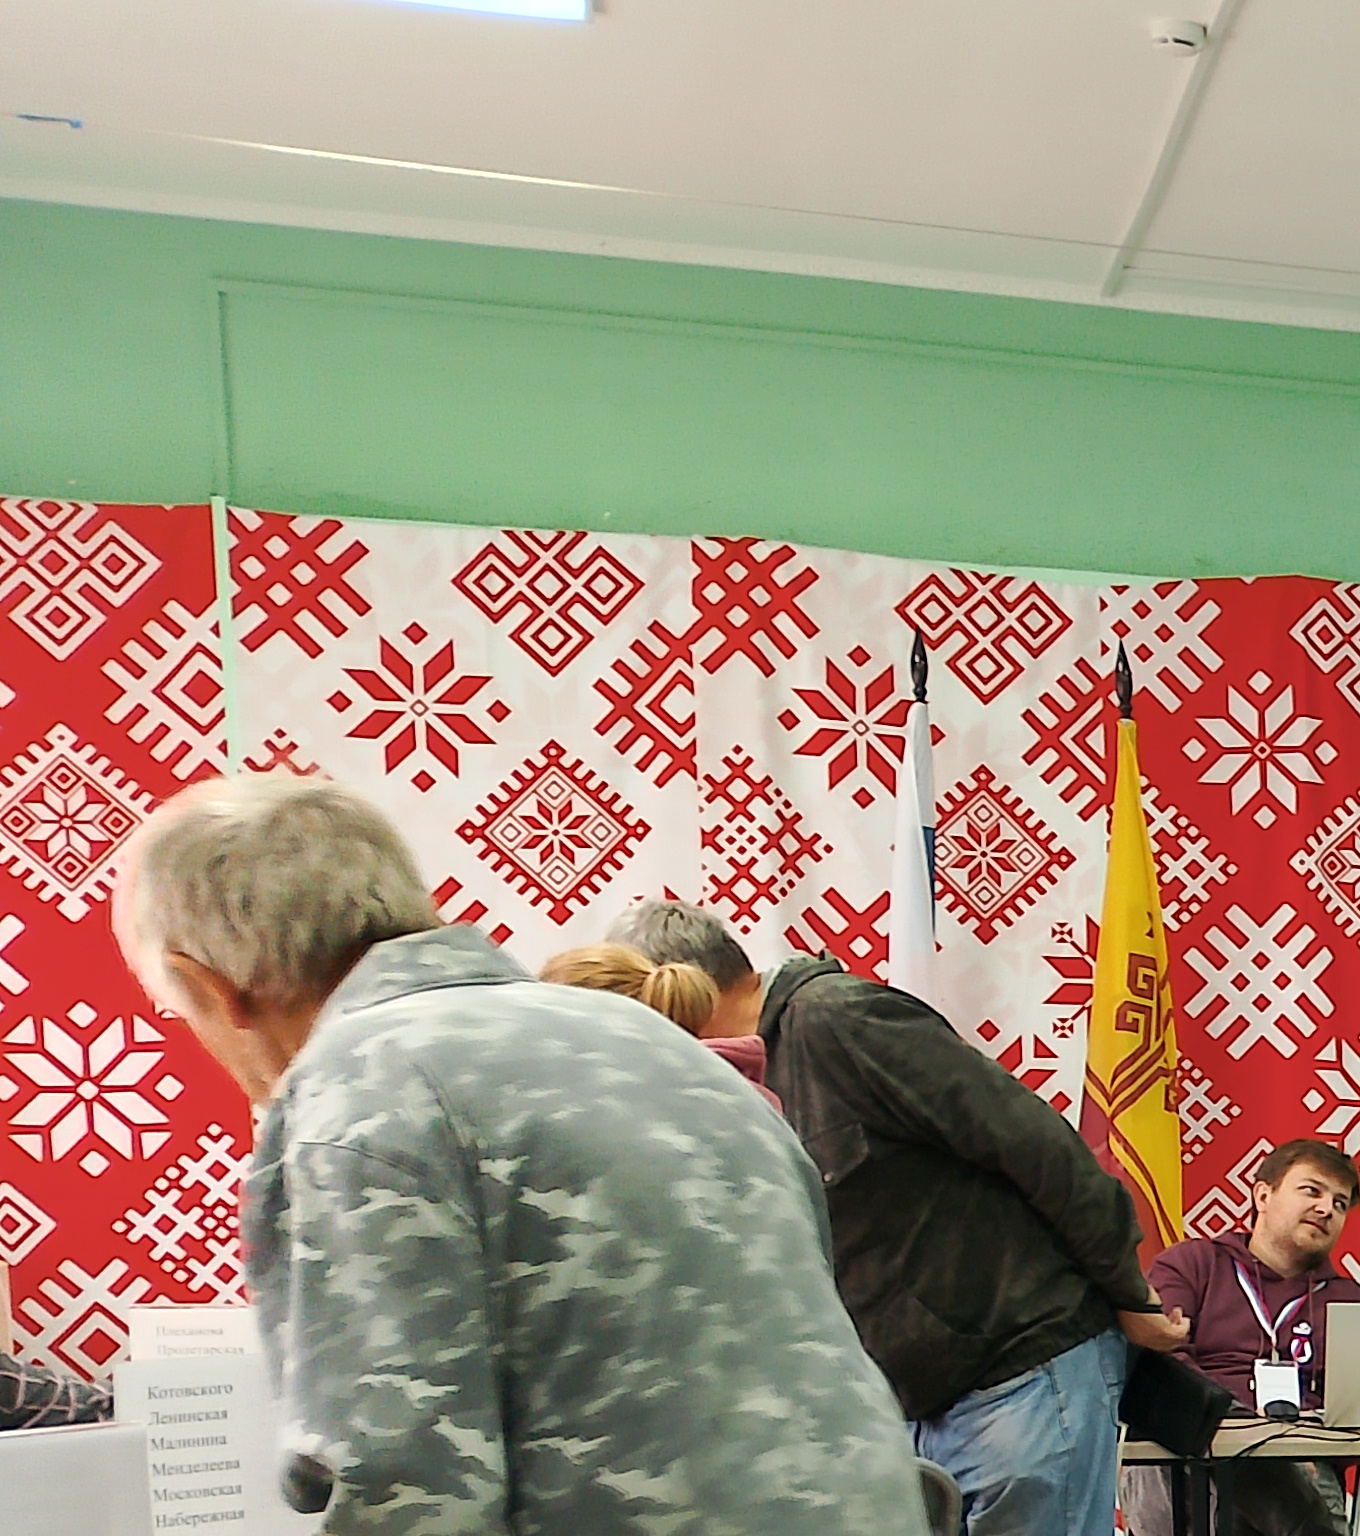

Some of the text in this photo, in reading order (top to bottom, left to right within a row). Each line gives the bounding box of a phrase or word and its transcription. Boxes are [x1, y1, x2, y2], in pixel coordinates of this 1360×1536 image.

[157, 1345, 245, 1357] Пролетарская
[147, 1384, 233, 1400] Котовского
[147, 1410, 228, 1426] Ленинская
[150, 1435, 228, 1451] Малинина
[152, 1460, 241, 1477] Менделеева
[153, 1485, 242, 1502] Московская
[155, 1510, 245, 1528] Набережная
